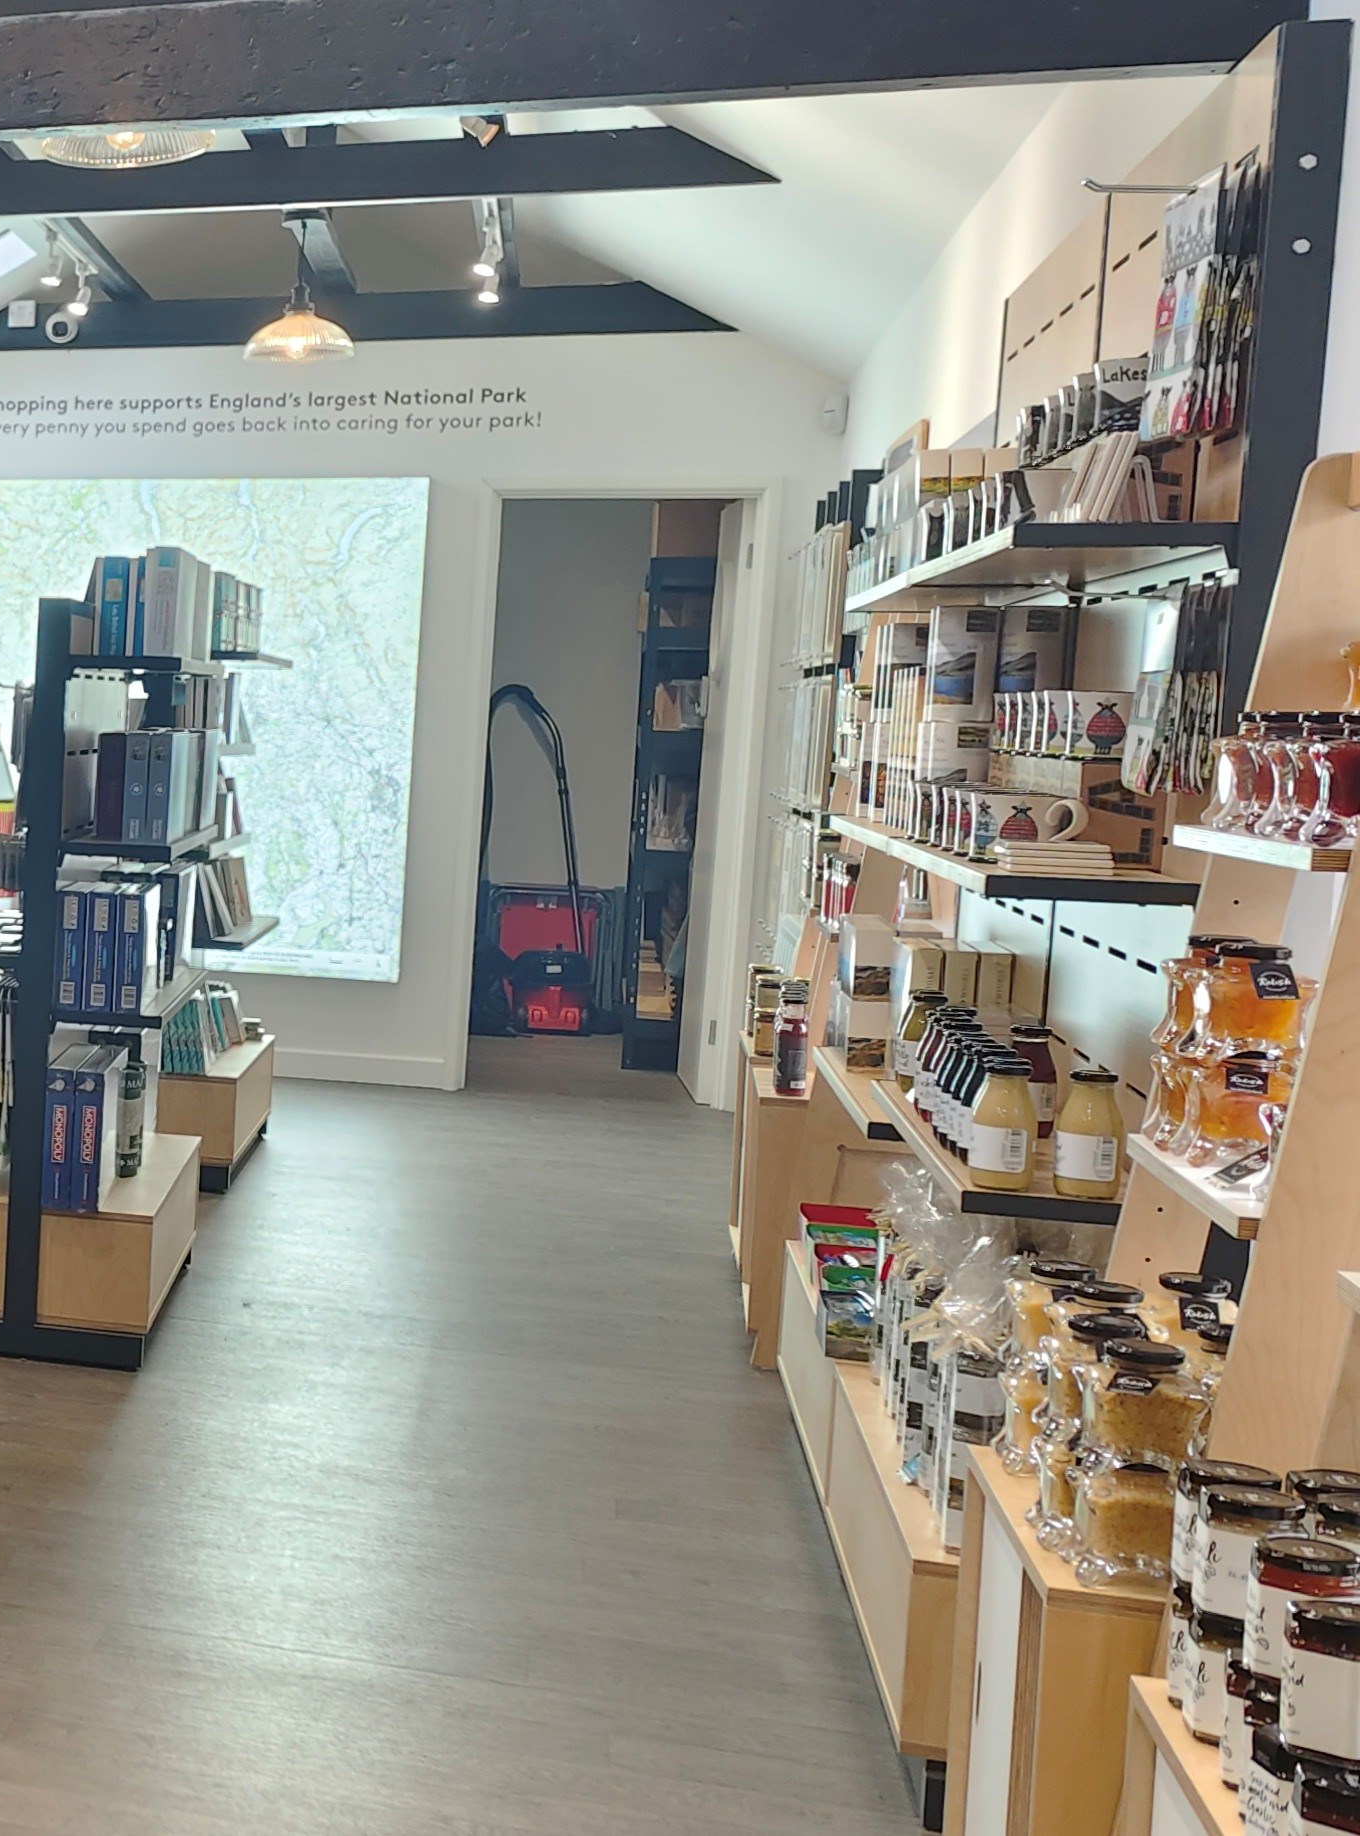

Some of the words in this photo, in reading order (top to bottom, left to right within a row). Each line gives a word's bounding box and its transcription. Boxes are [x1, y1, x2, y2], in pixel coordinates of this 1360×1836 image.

[73, 395, 114, 412] here
[119, 394, 203, 415] supports
[208, 391, 302, 413] England’s
[307, 390, 378, 412] largest
[383, 388, 475, 407] National
[480, 386, 528, 404] Park
[35, 421, 91, 439] penny
[94, 421, 127, 439] you
[132, 417, 187, 438] spend
[192, 420, 236, 438] goes
[241, 416, 287, 434] back
[292, 414, 332, 432] into
[336, 413, 399, 435] caring
[404, 412, 434, 430] for
[438, 415, 483, 434] your
[488, 411, 543, 433] park!
[52, 1106, 65, 1162] MONOPOLY
[82, 1106, 95, 1163] MONOPOLY
